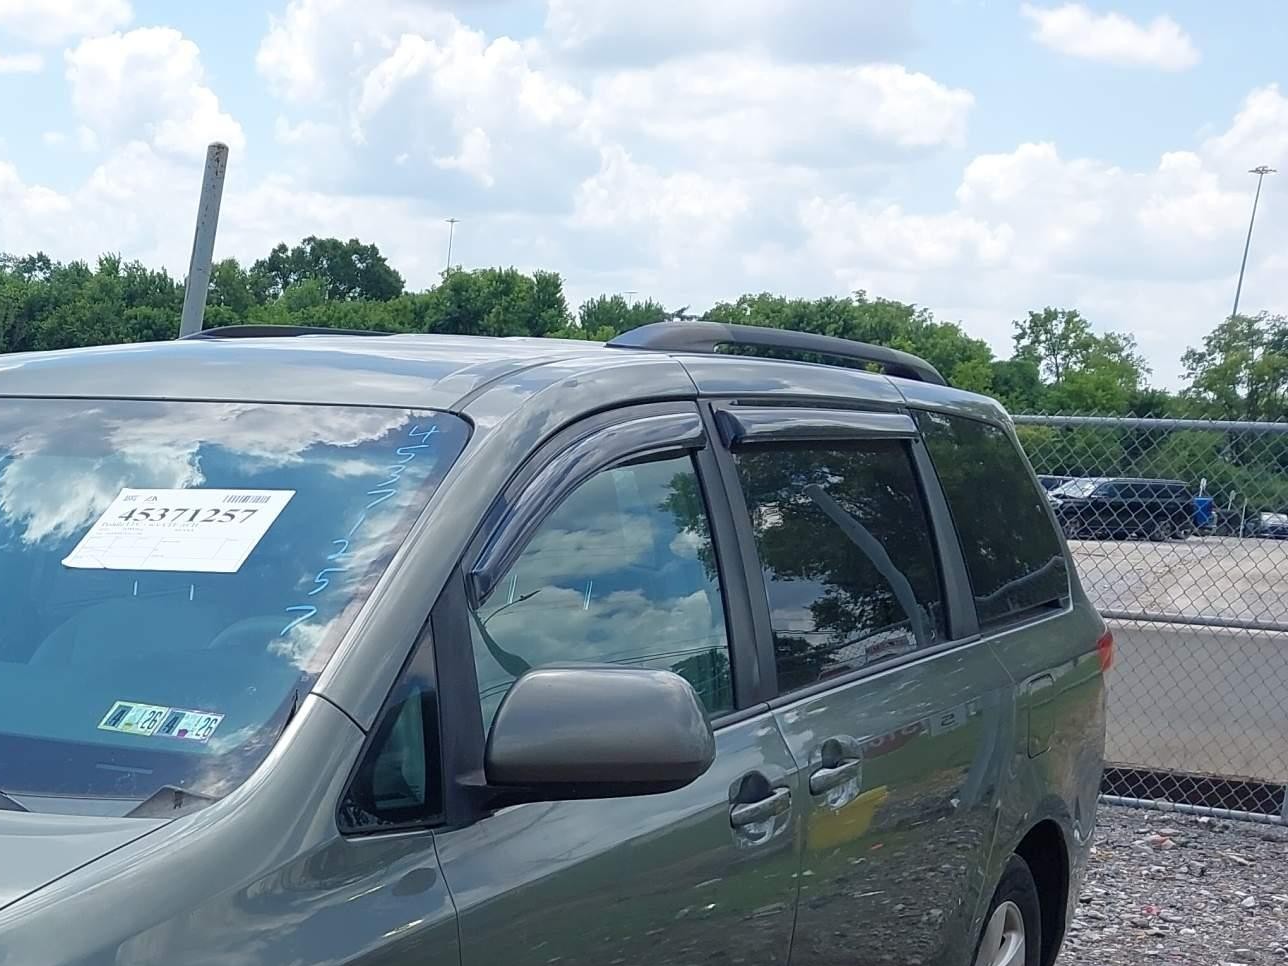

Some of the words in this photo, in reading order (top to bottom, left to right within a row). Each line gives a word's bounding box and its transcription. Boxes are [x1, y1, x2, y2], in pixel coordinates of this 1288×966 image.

[119, 507, 258, 523] 45371257
[140, 710, 162, 730] 26
[195, 717, 218, 738] 26
